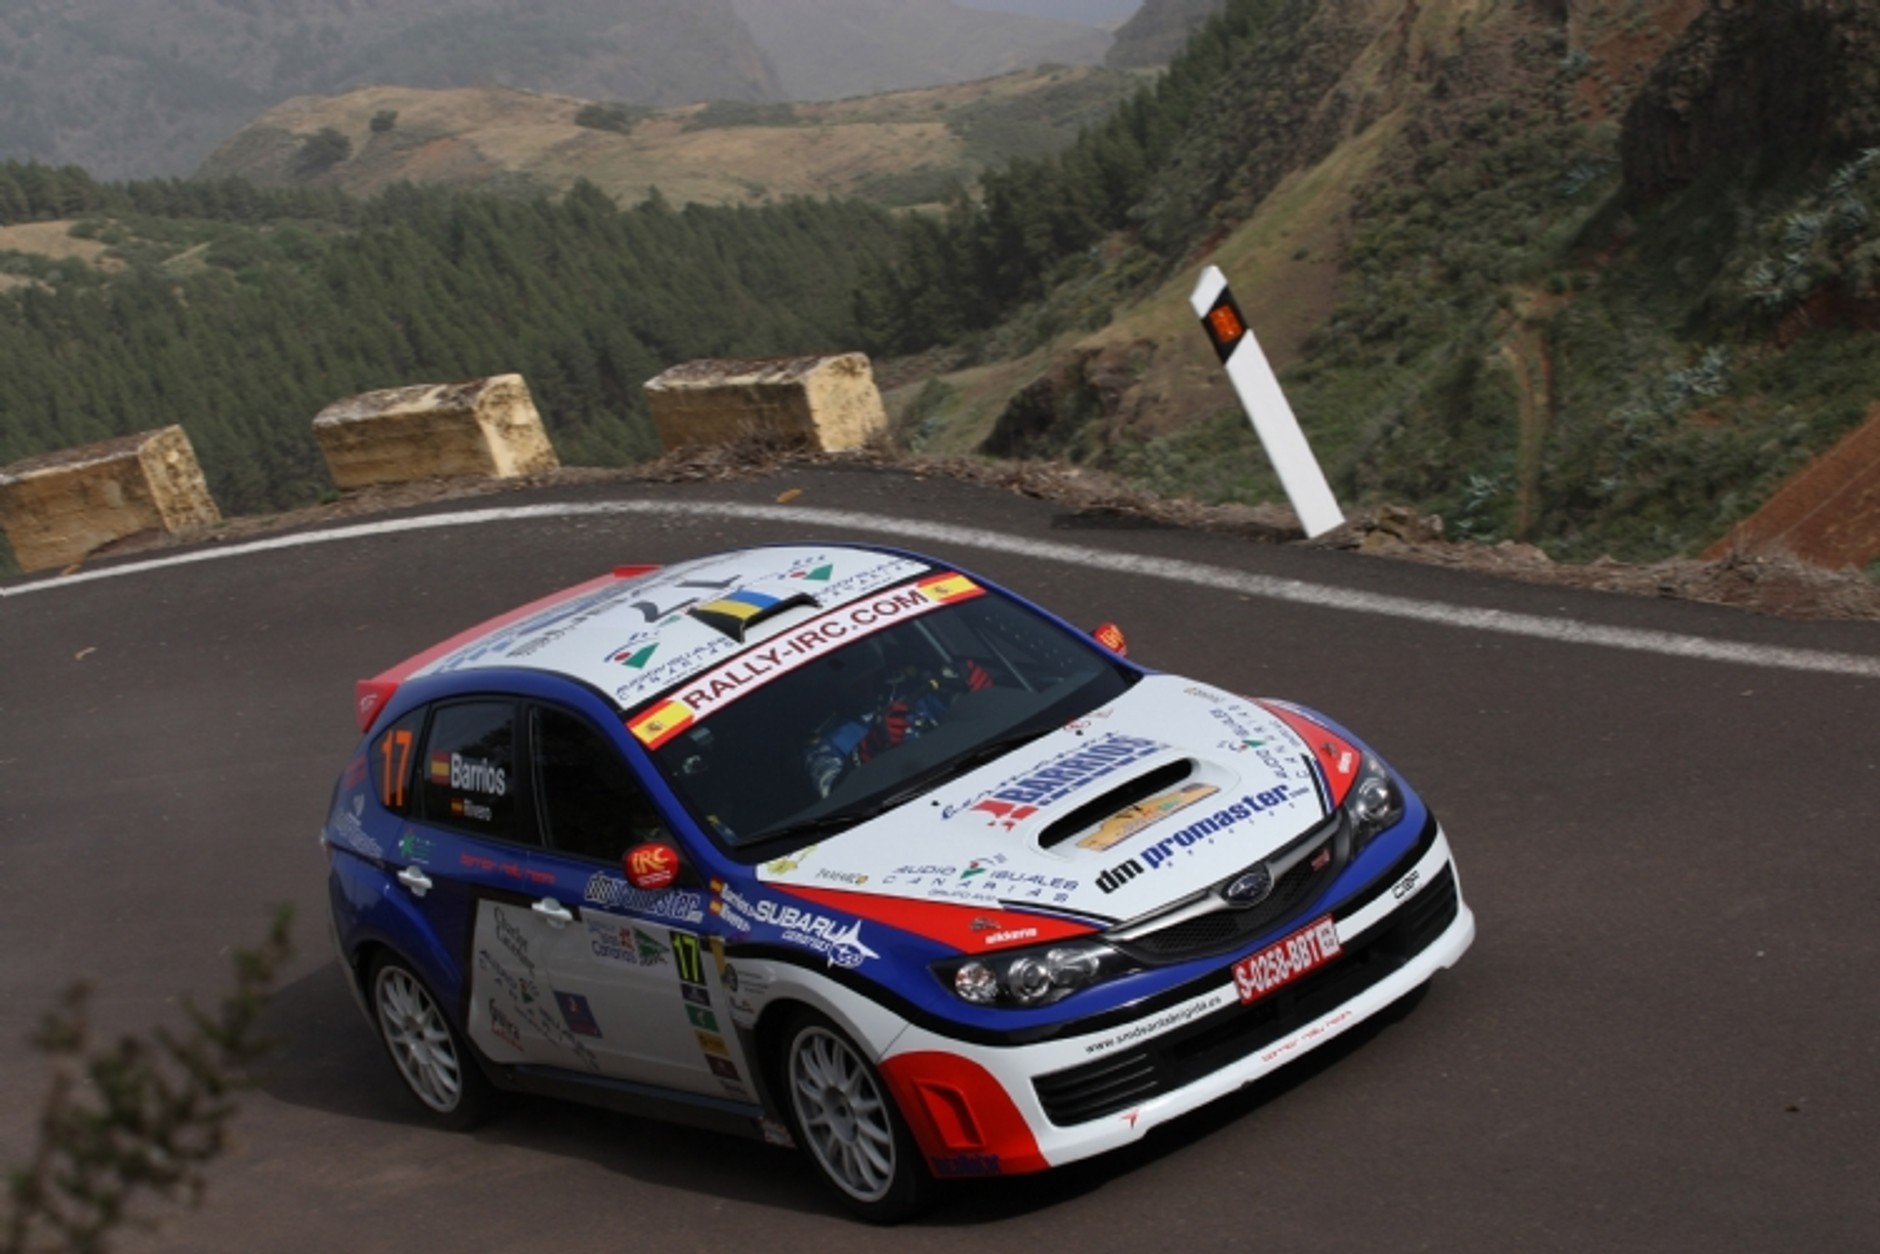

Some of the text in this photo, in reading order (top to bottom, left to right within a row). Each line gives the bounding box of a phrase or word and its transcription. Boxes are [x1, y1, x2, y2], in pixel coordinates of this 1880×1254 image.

[682, 590, 928, 710] RALLY-IRC.COM
[379, 728, 413, 808] 17
[451, 752, 506, 796] Barrios
[992, 735, 1155, 803] BARRIOS
[630, 847, 669, 875] IRC
[1095, 858, 1145, 895] dm
[1140, 784, 1290, 870] promaster
[755, 899, 848, 943] SUBARU
[672, 934, 700, 983] 17
